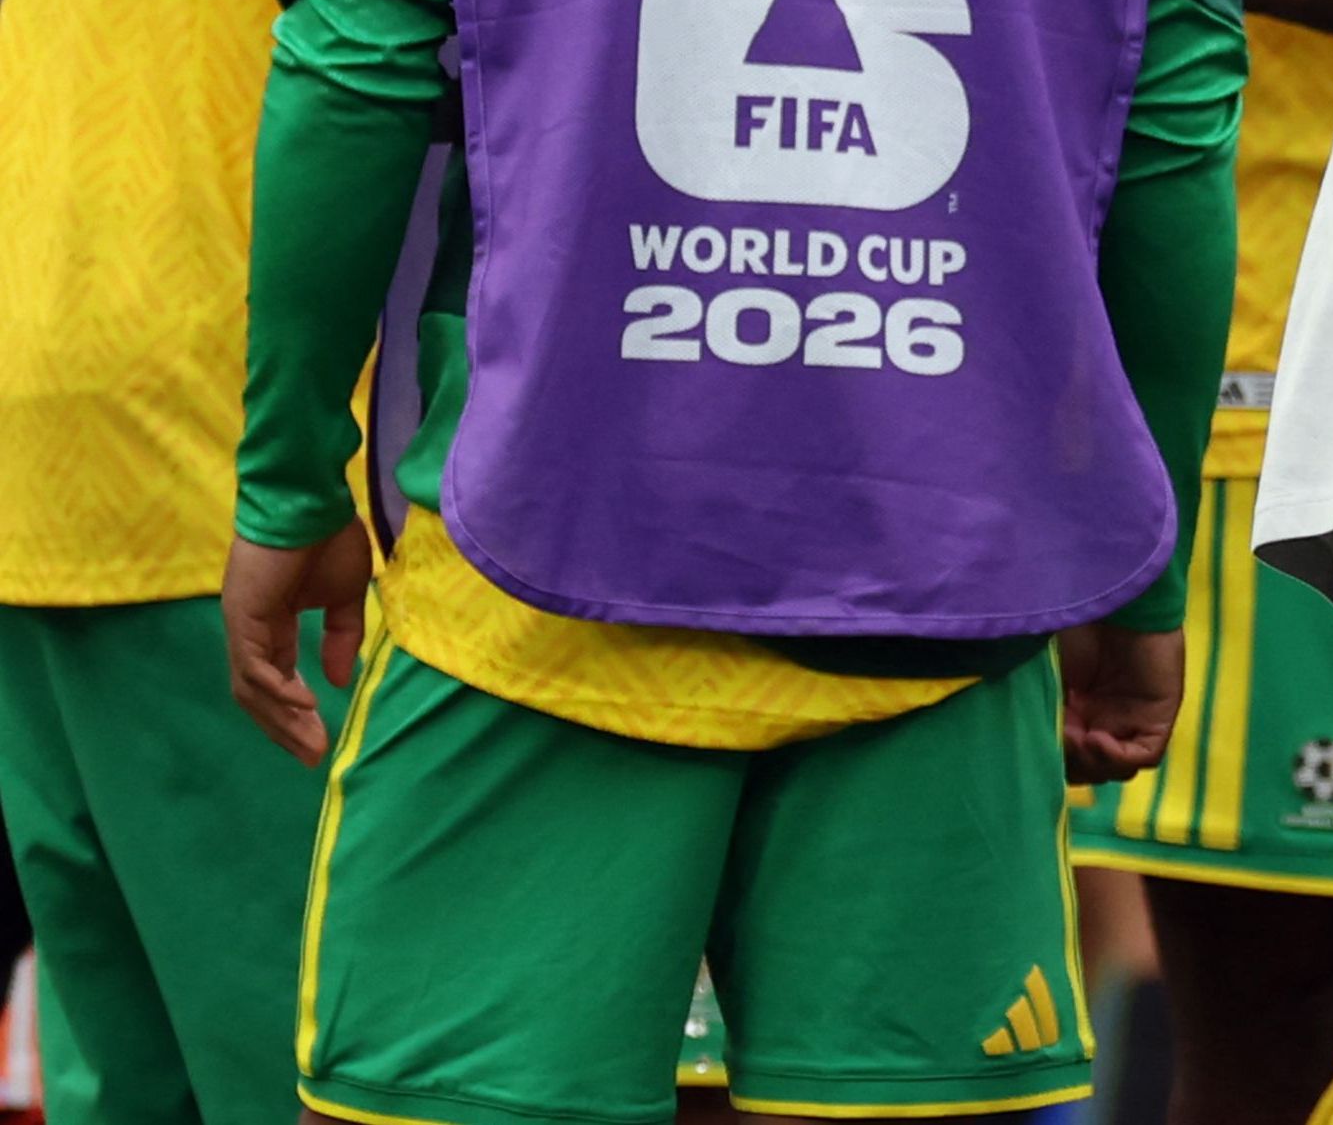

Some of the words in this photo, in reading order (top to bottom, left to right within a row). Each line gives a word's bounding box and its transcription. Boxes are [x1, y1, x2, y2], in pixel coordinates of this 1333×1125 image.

[734, 95, 878, 157] FIFA
[629, 224, 848, 278] WORLD
[857, 234, 967, 286] CUP
[621, 284, 965, 376] 2026
